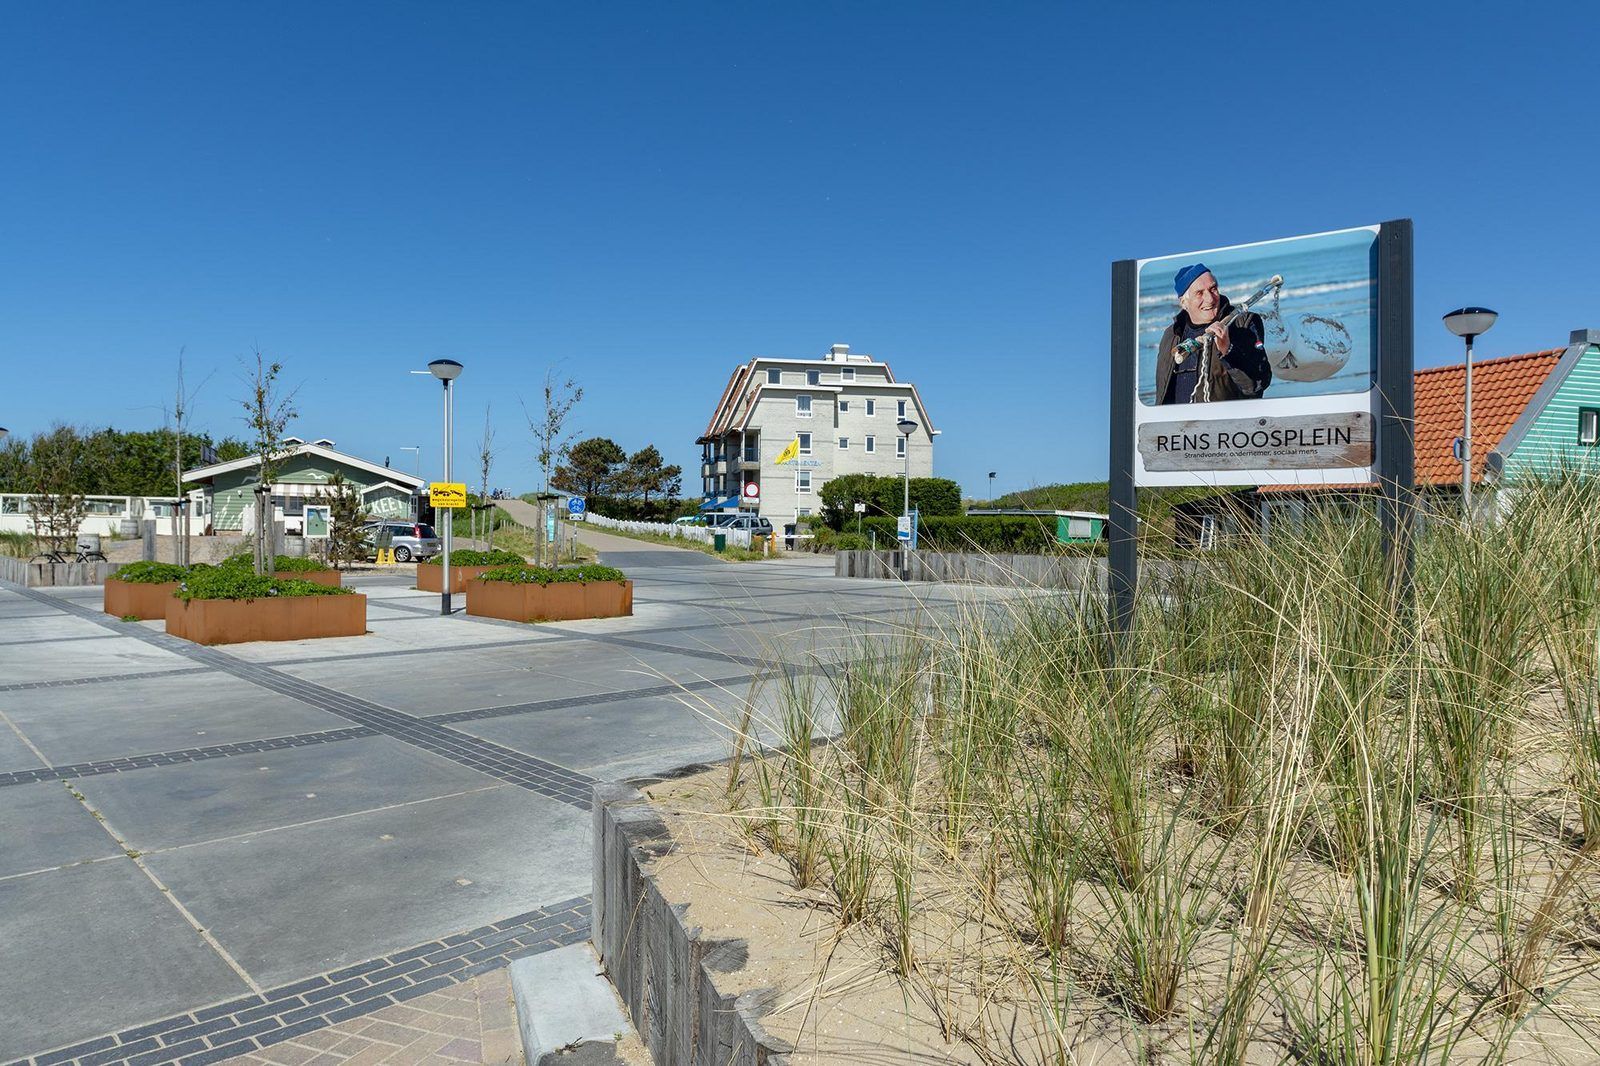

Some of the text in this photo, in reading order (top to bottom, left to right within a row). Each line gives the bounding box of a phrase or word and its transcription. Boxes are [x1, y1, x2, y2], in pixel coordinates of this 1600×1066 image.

[1157, 427, 1351, 452] RENS ROOSPLEIN
[1184, 451, 1228, 459] Strandvonder,
[1229, 449, 1272, 458] ondernemer,
[1273, 448, 1297, 456] sociaal
